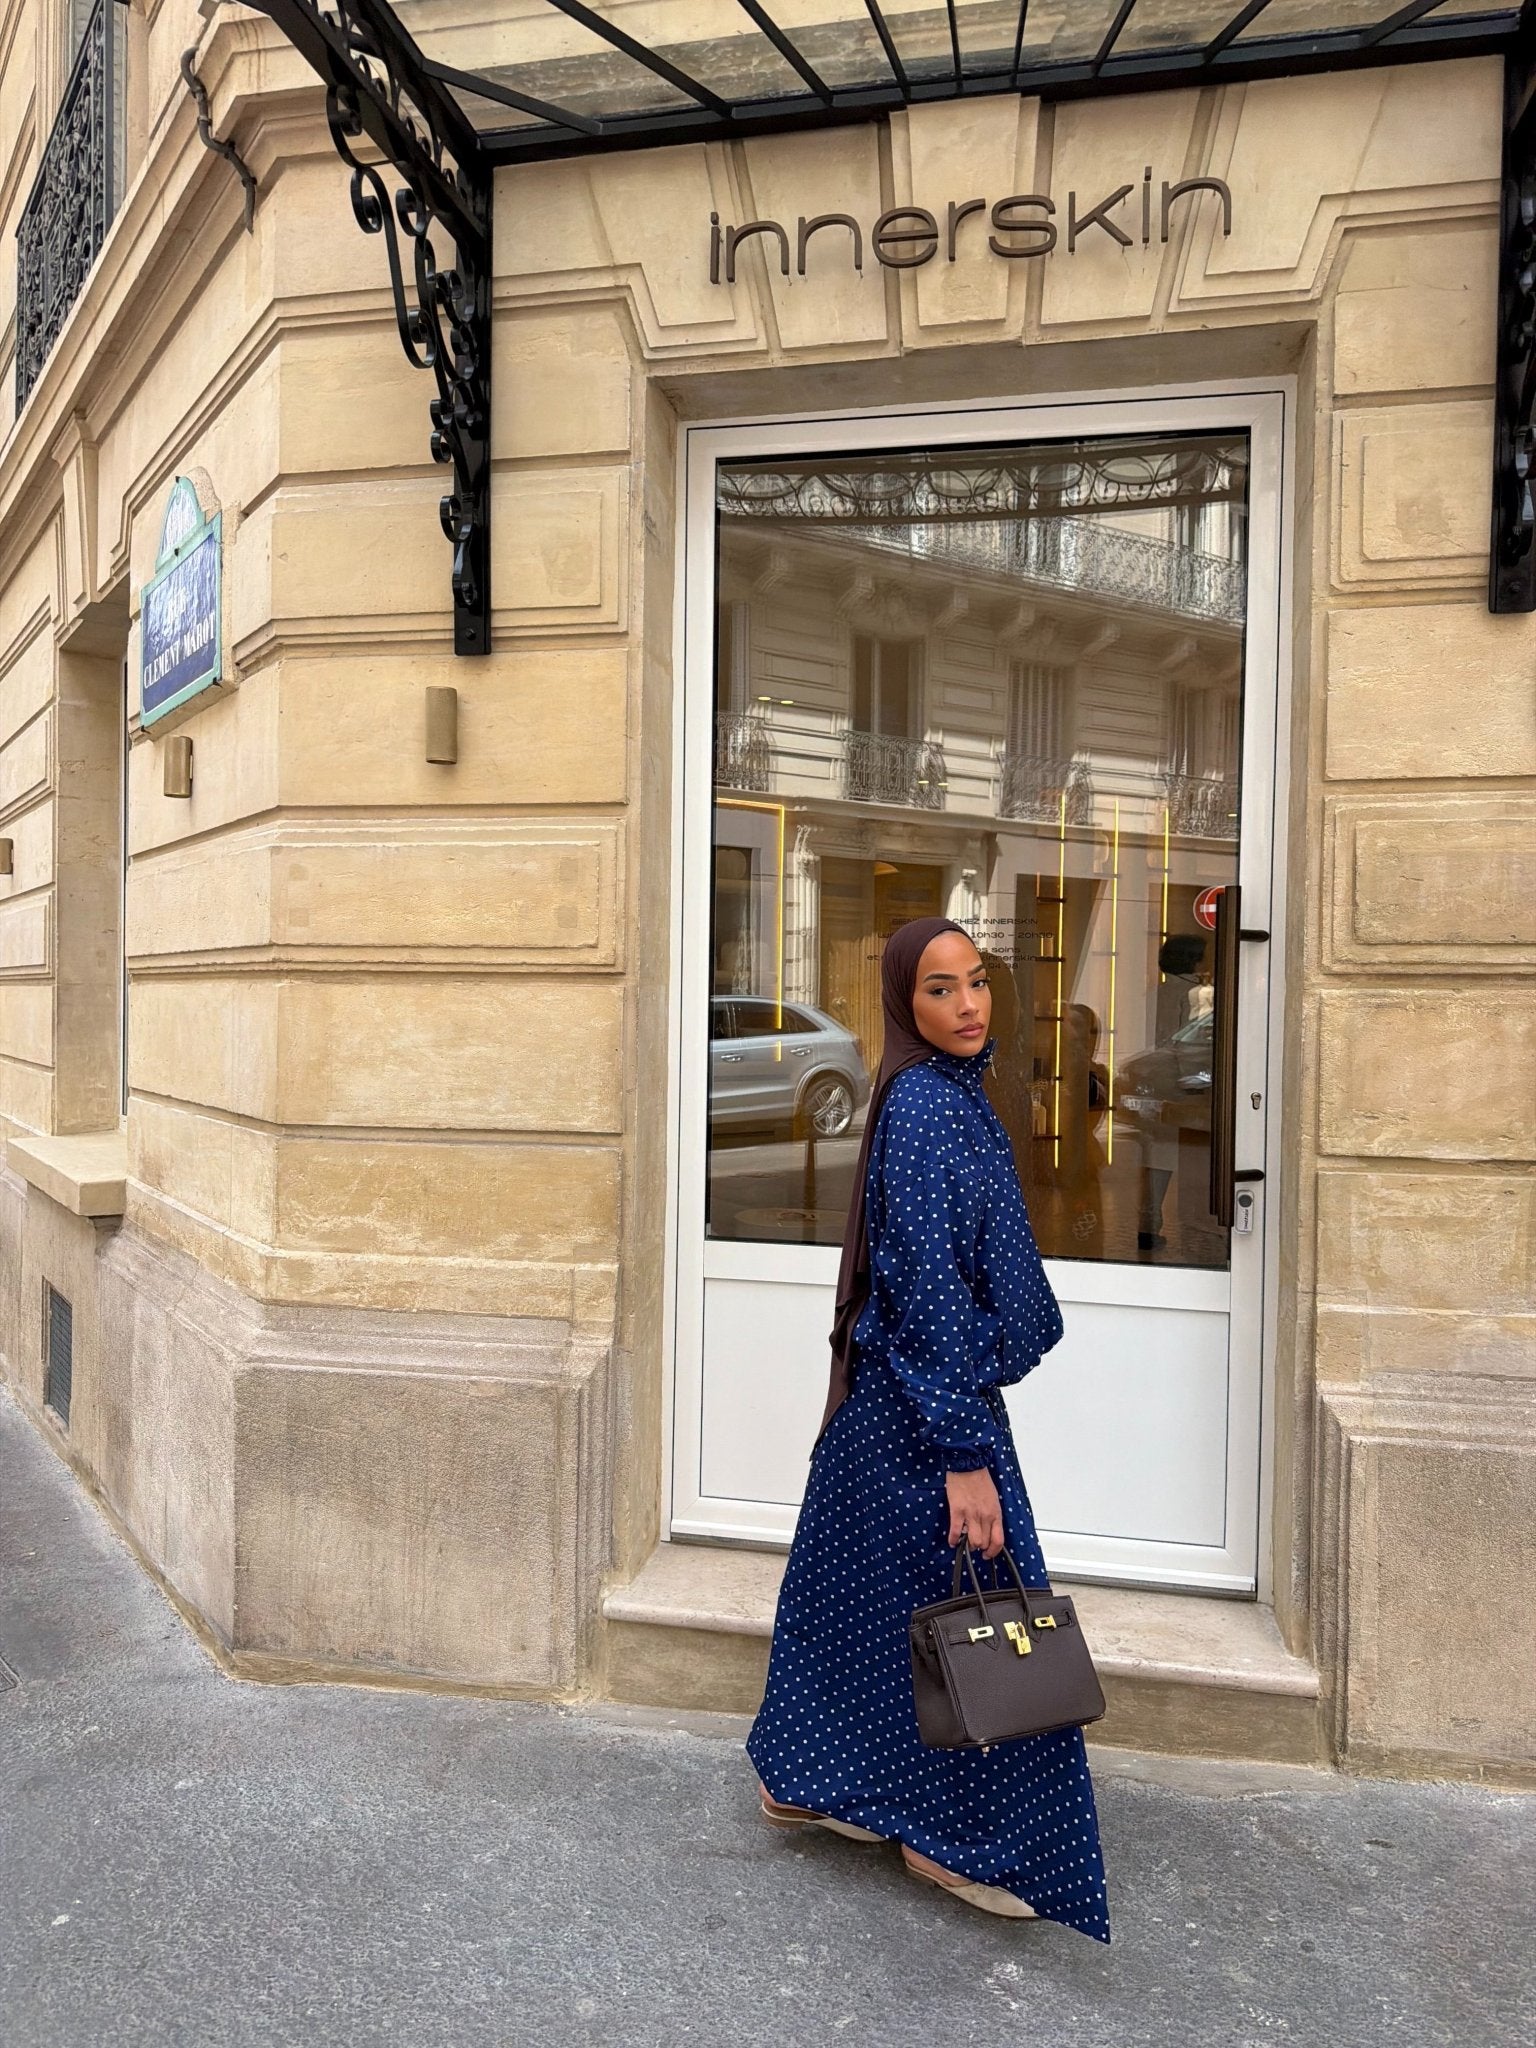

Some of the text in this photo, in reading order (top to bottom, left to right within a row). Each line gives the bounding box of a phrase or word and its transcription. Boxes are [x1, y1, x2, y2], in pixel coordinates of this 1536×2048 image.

[709, 166, 1232, 285] innerskin
[184, 611, 215, 659] MAROT
[971, 931, 1005, 939] 10h30
[1017, 931, 1053, 939] 20h30
